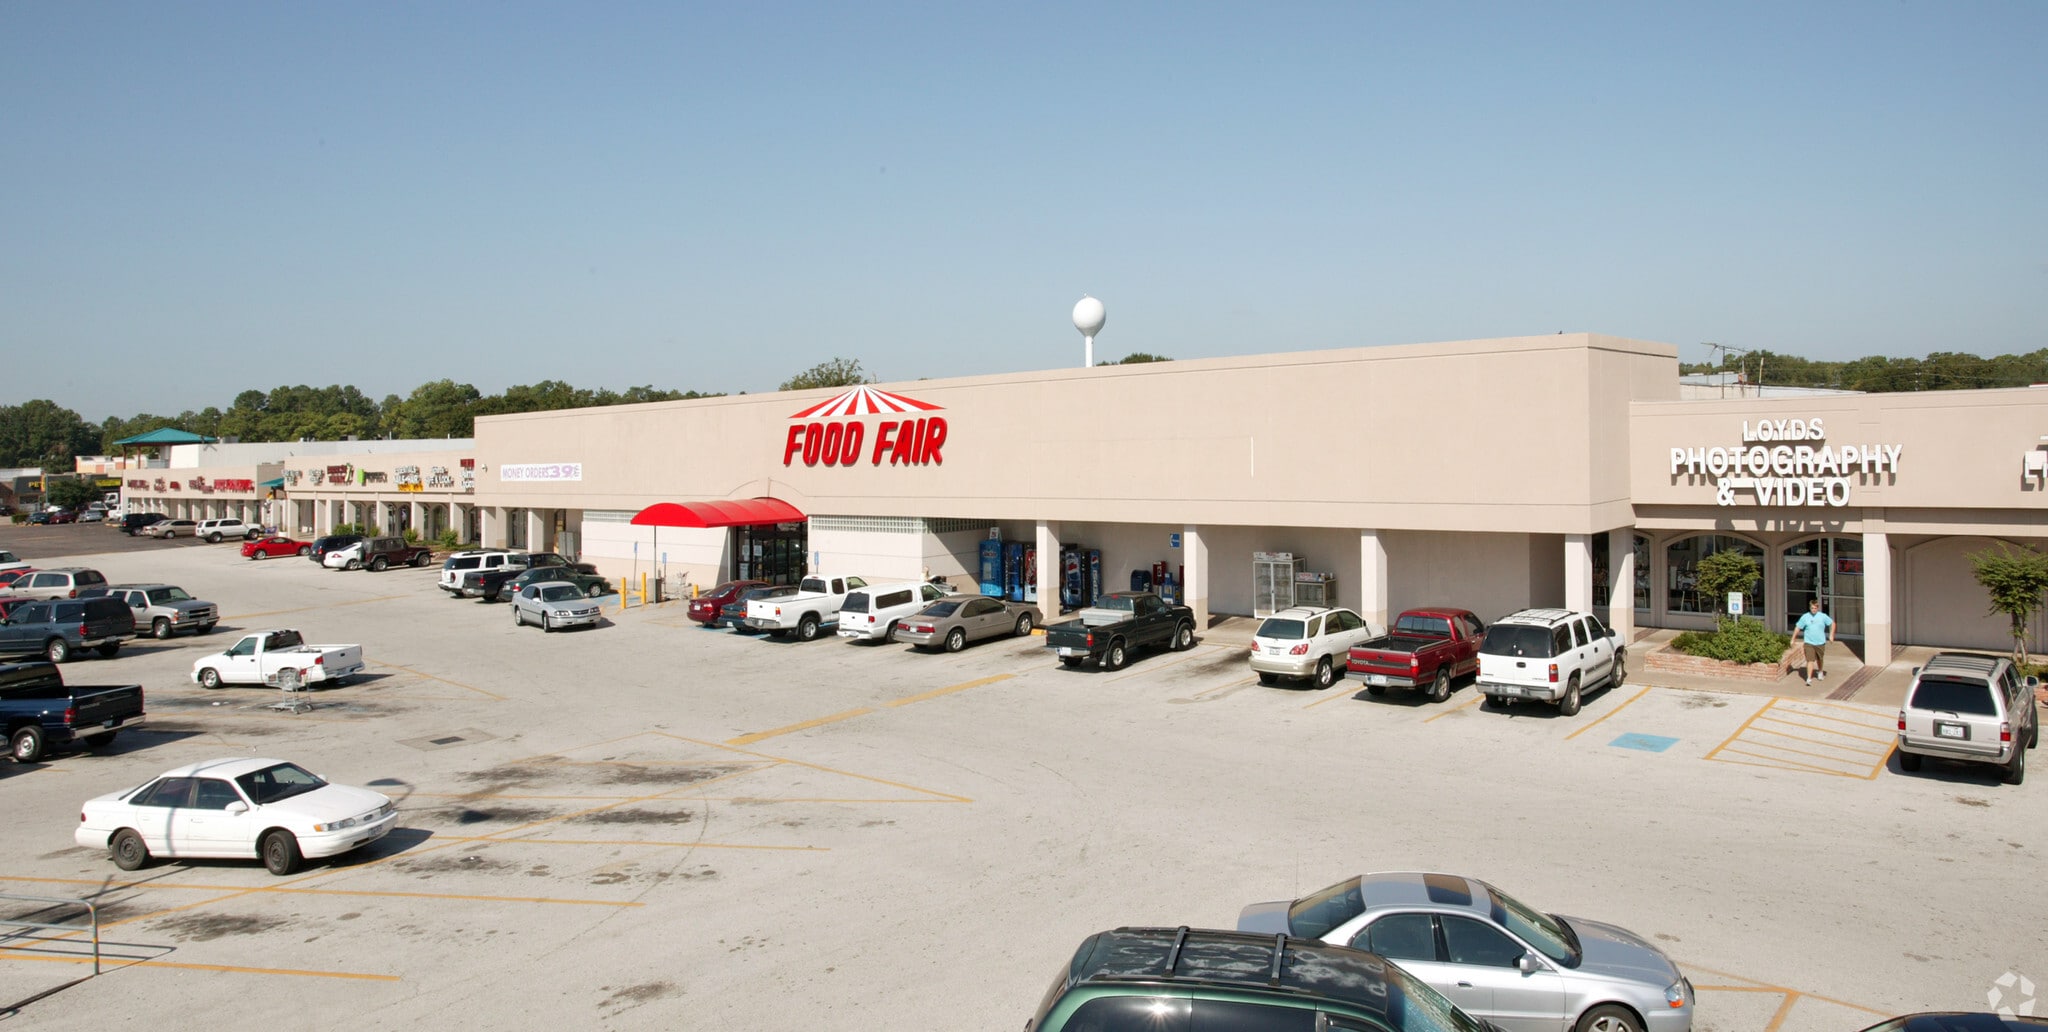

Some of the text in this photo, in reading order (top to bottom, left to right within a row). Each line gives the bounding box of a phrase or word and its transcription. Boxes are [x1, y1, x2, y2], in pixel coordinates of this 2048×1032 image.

[783, 416, 947, 466] FOOD FAIR
[1743, 417, 1825, 442] LOYDS
[502, 467, 524, 479] MONEY
[525, 466, 549, 479] ORDERS
[1670, 444, 1903, 475] PHOTOGRAPHY
[1716, 477, 1850, 507] & VIDEO
